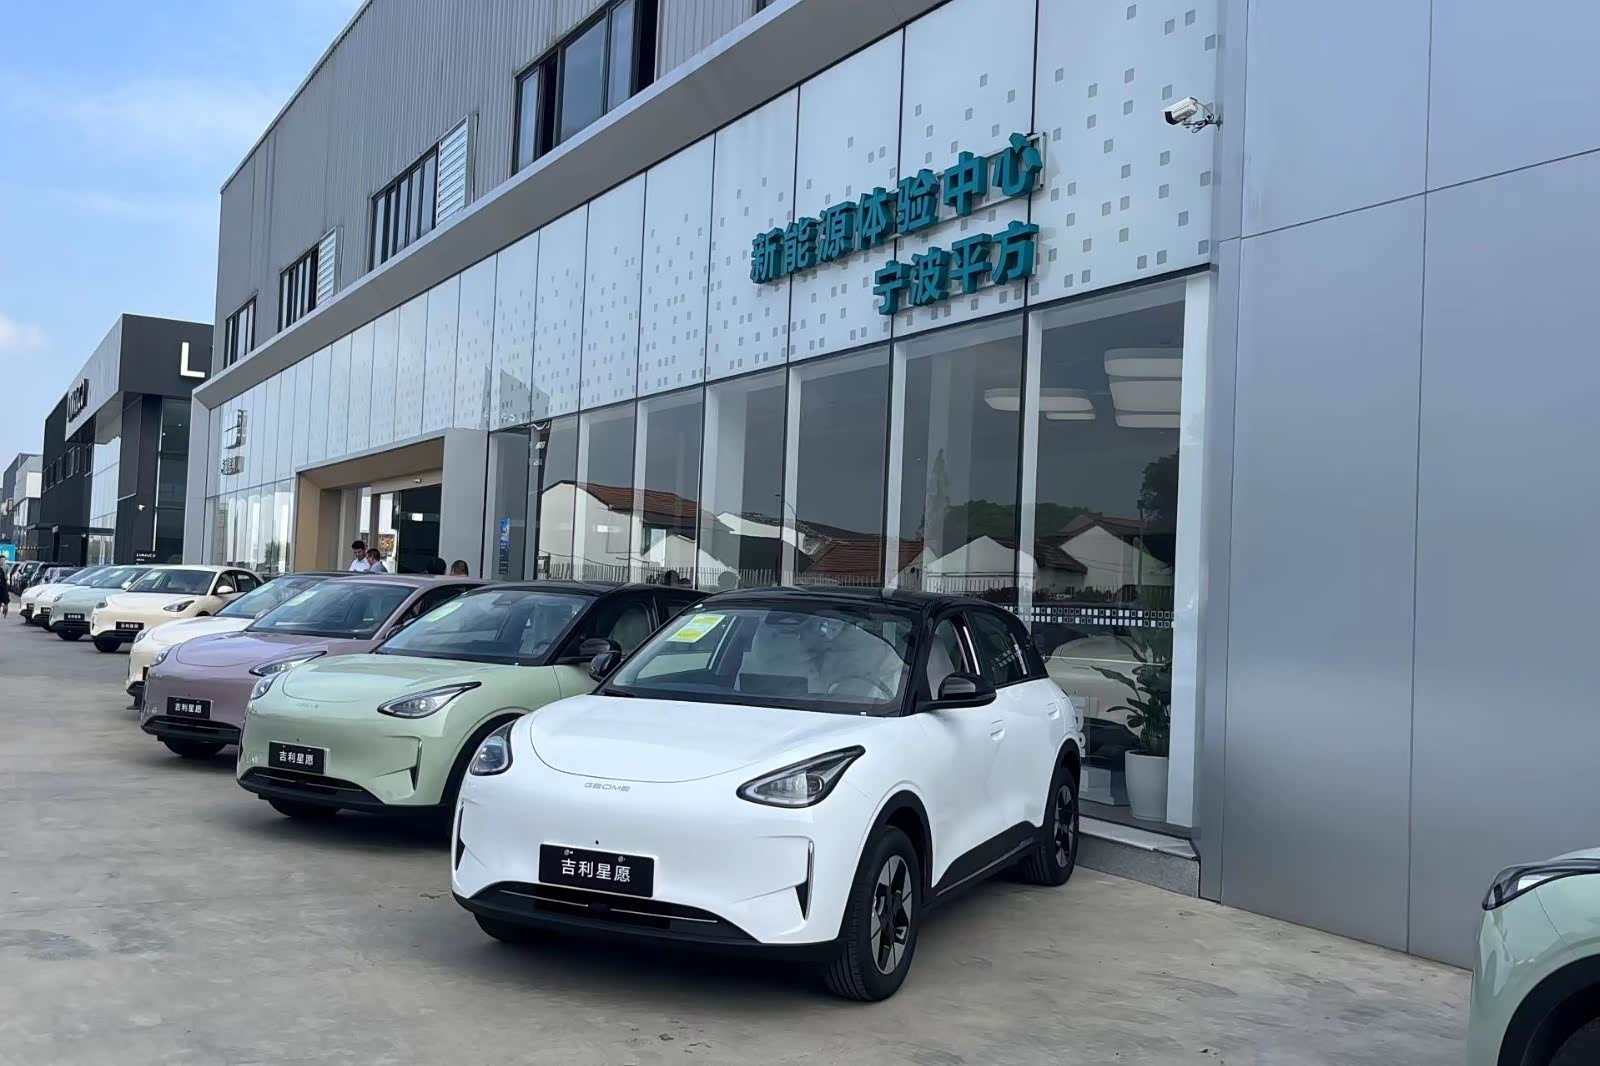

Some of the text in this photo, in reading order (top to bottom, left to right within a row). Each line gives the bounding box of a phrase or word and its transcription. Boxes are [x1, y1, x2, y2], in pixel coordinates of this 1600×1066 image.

[750, 132, 1042, 284] 新能源体验中心
[873, 220, 1039, 315] 宁波平方
[278, 750, 314, 766] 吉利星愿
[560, 858, 631, 882] 吉利星愿
